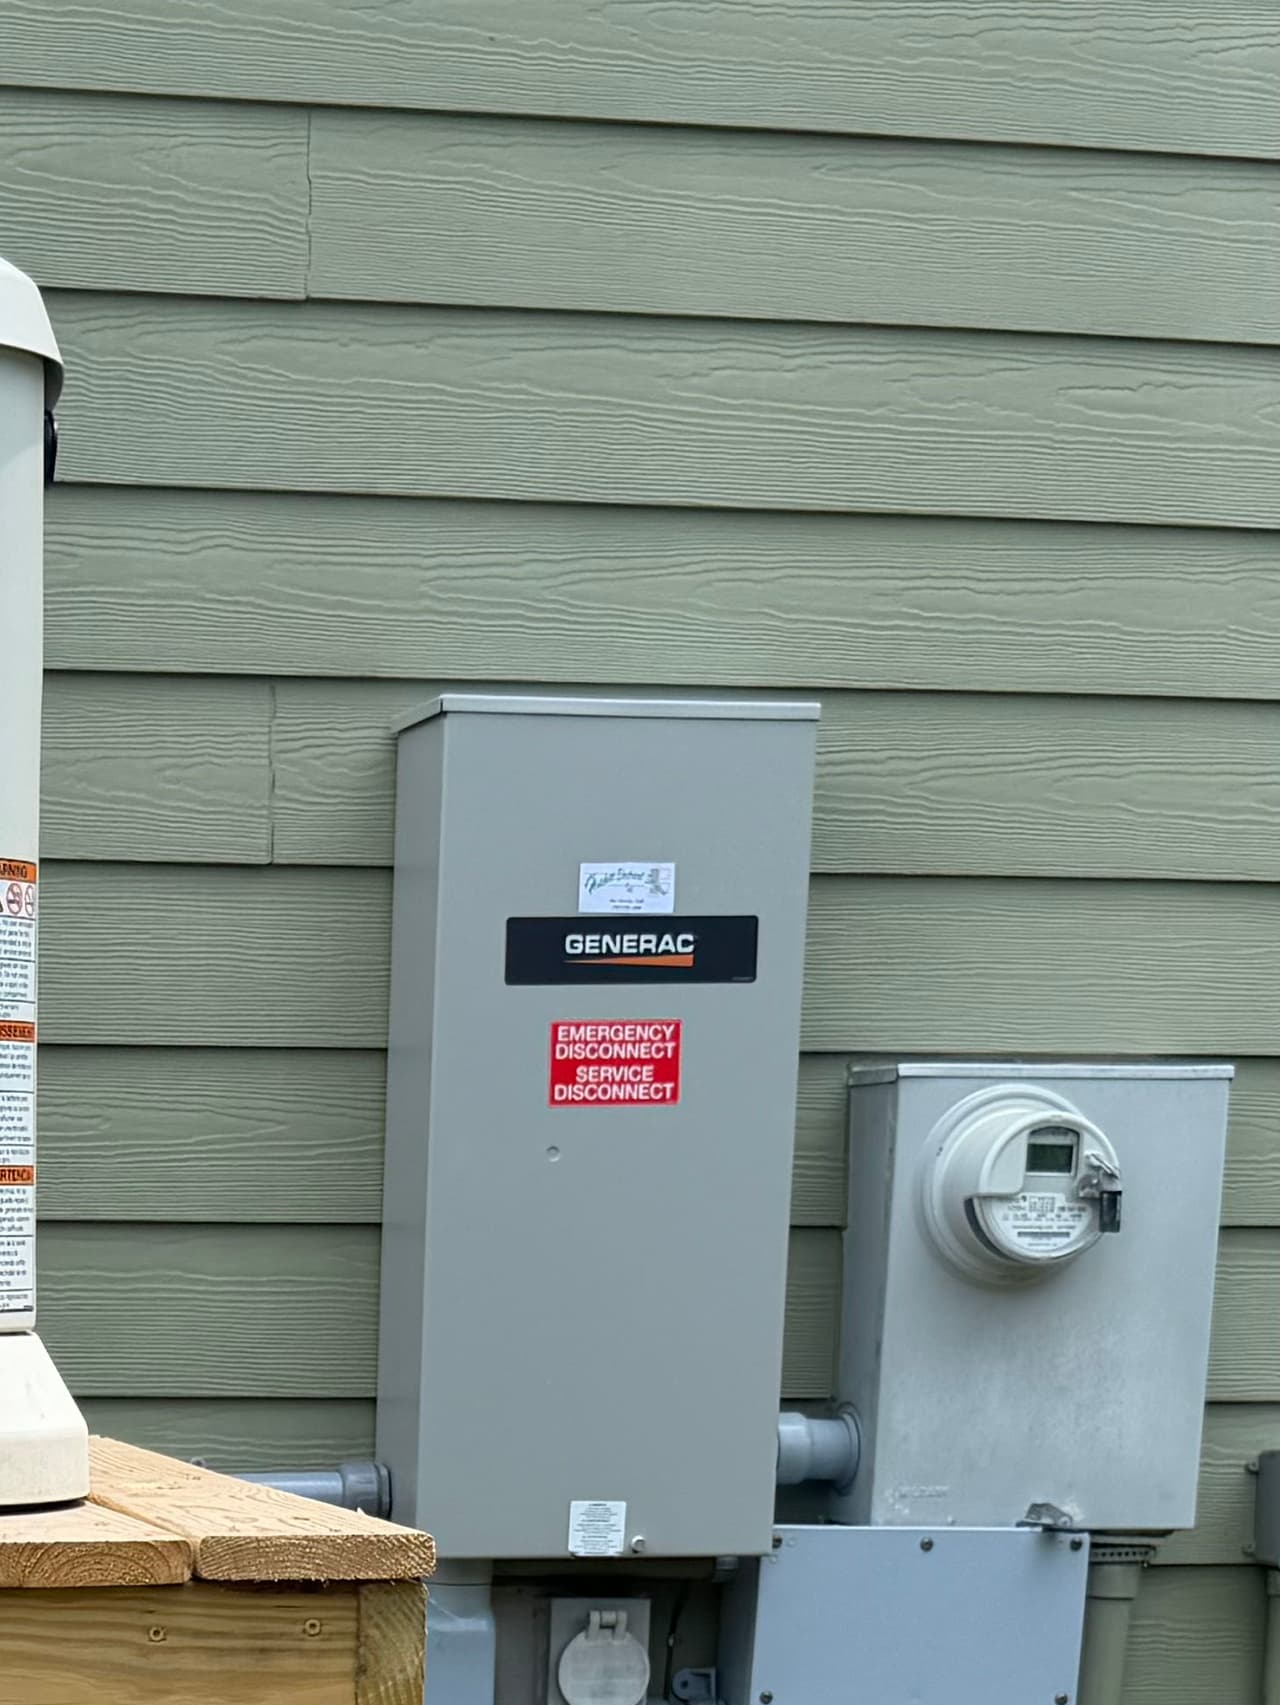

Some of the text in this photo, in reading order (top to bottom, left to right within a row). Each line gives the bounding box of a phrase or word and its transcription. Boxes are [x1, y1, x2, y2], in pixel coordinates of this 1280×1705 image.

[564, 933, 695, 955] GENERAC
[557, 1024, 675, 1042] EMERGENCY
[555, 1042, 676, 1060] DISCONNECT
[575, 1064, 655, 1083] SERVICE
[554, 1083, 675, 1101] DISCONNECT
